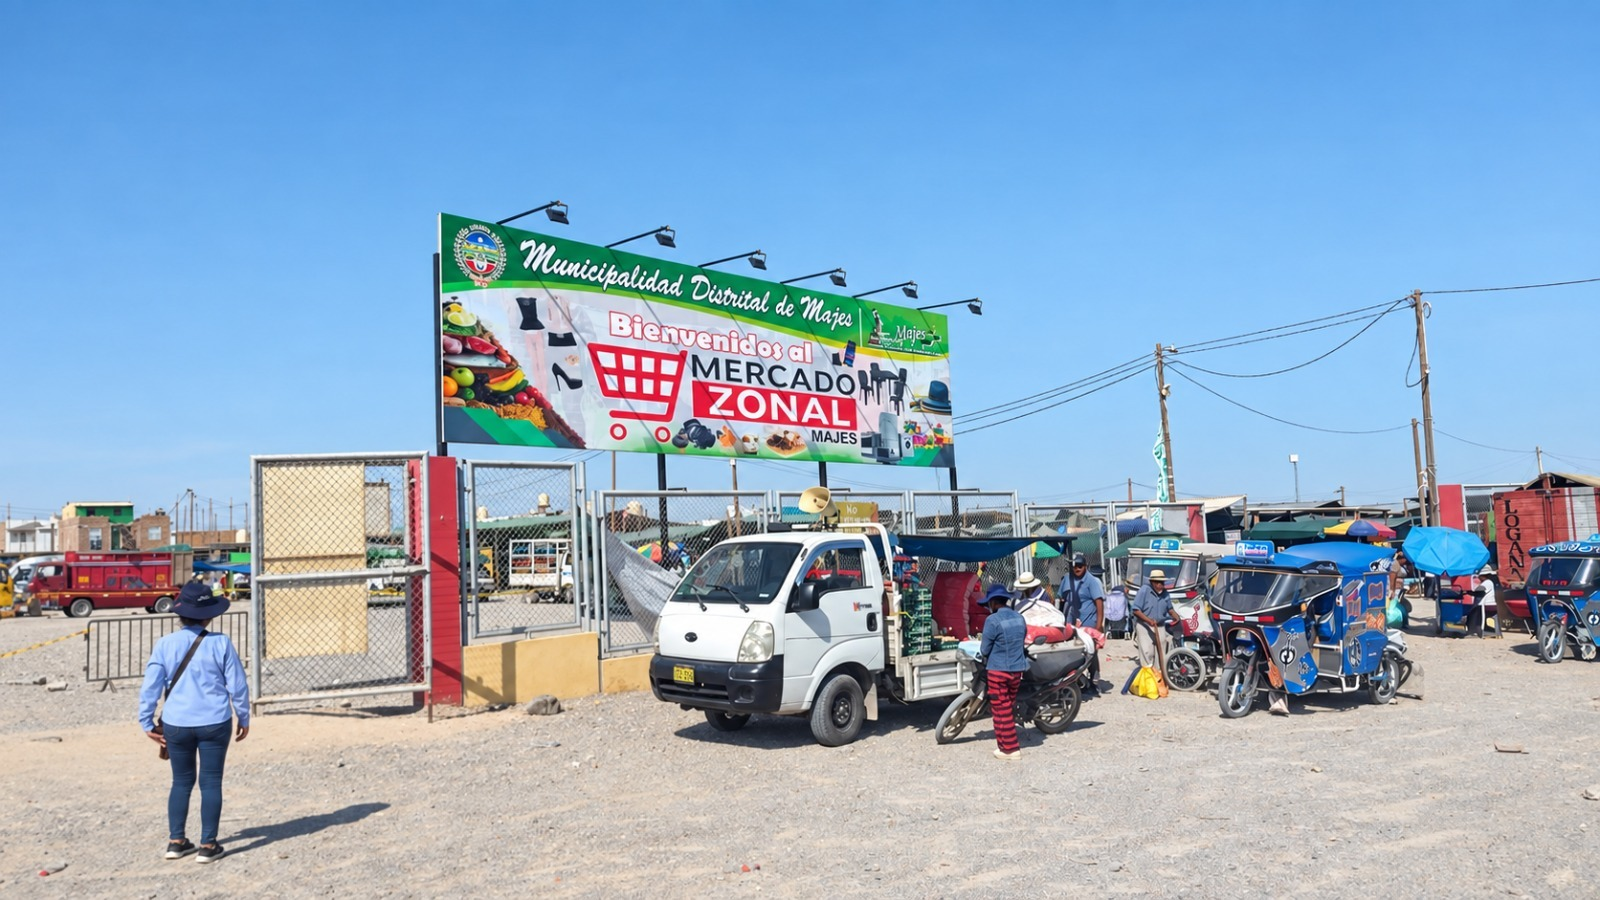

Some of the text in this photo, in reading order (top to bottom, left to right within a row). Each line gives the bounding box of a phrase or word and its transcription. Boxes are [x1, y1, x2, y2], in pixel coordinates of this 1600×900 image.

[519, 239, 684, 292] Municipalidad
[691, 274, 770, 312] Distrital
[775, 294, 795, 317] de
[800, 295, 853, 331] Majes
[608, 311, 813, 364] Bienvenidos al
[895, 325, 926, 347] Majes
[691, 354, 856, 396] MERCADO
[708, 385, 852, 427] ZONAL
[811, 429, 858, 445] MAJES
